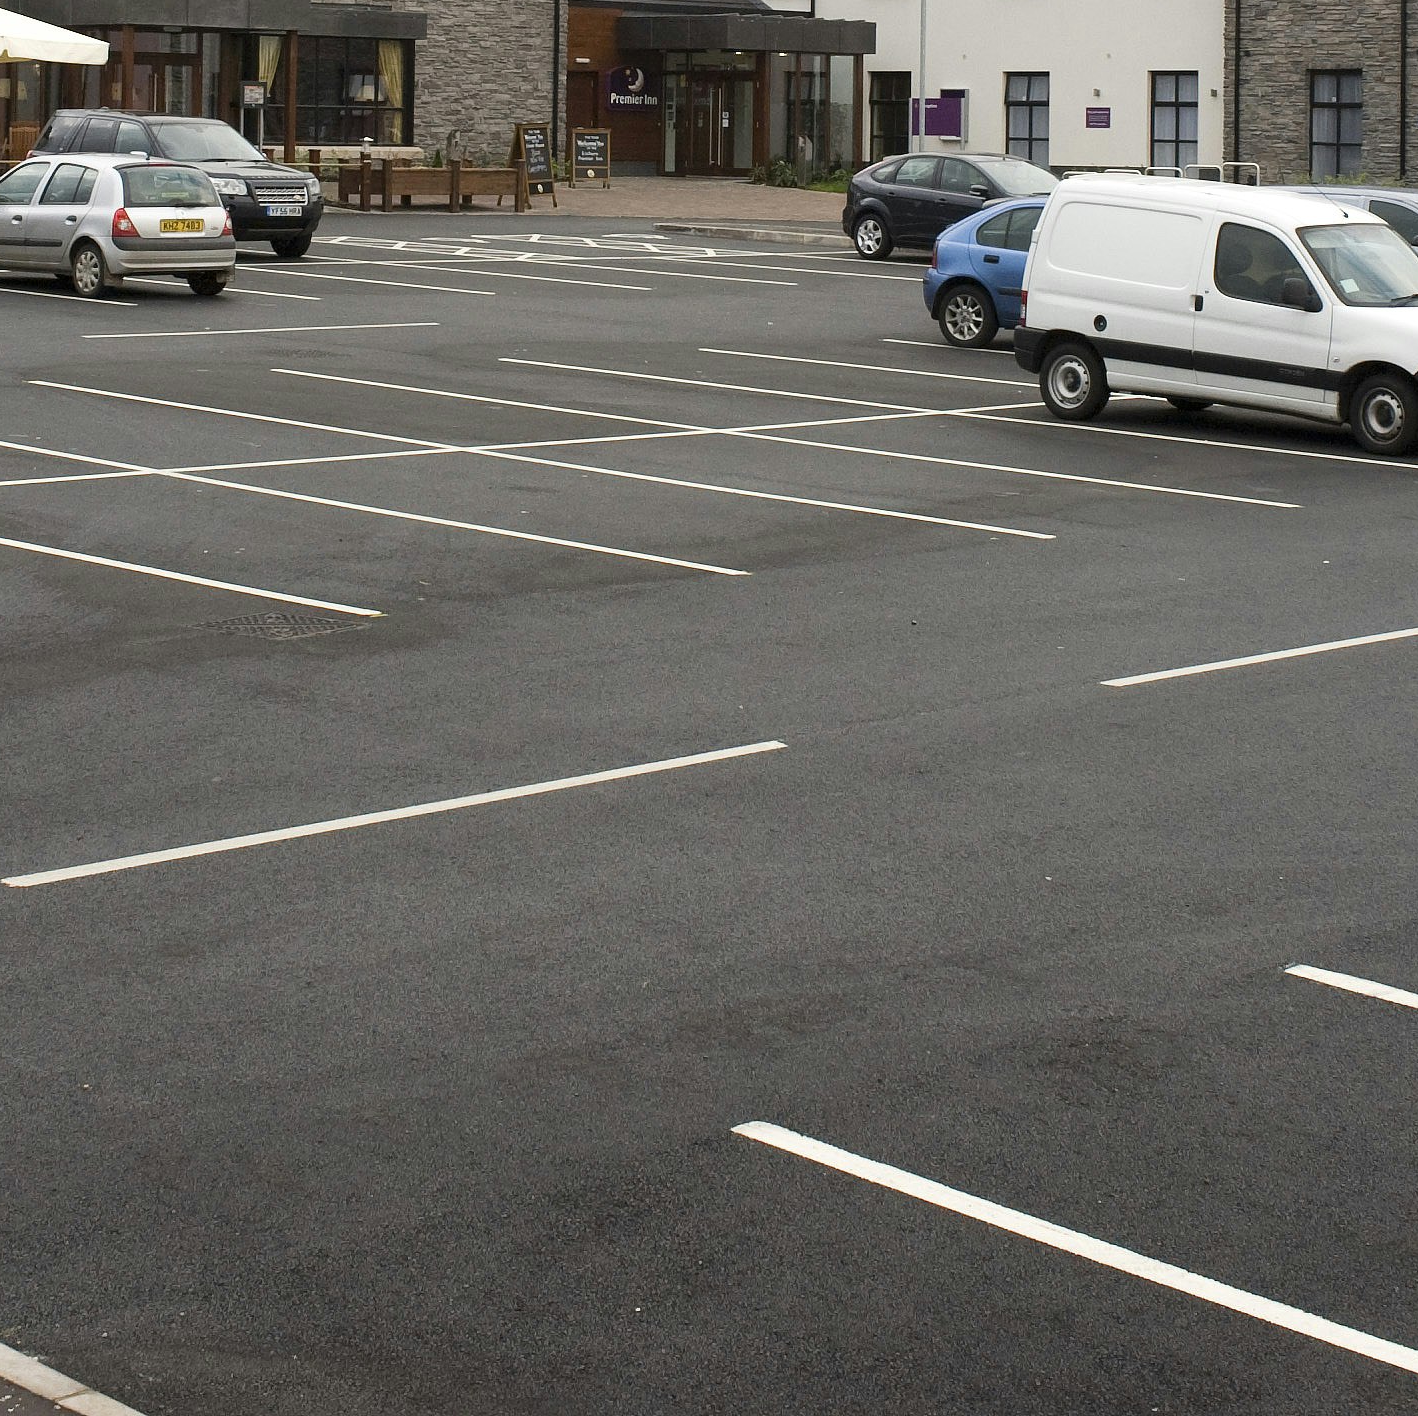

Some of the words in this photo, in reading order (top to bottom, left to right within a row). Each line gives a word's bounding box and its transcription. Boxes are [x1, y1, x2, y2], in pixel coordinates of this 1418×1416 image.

[610, 92, 643, 104] Premier
[645, 94, 658, 105] Inn
[163, 221, 179, 231] KHZ
